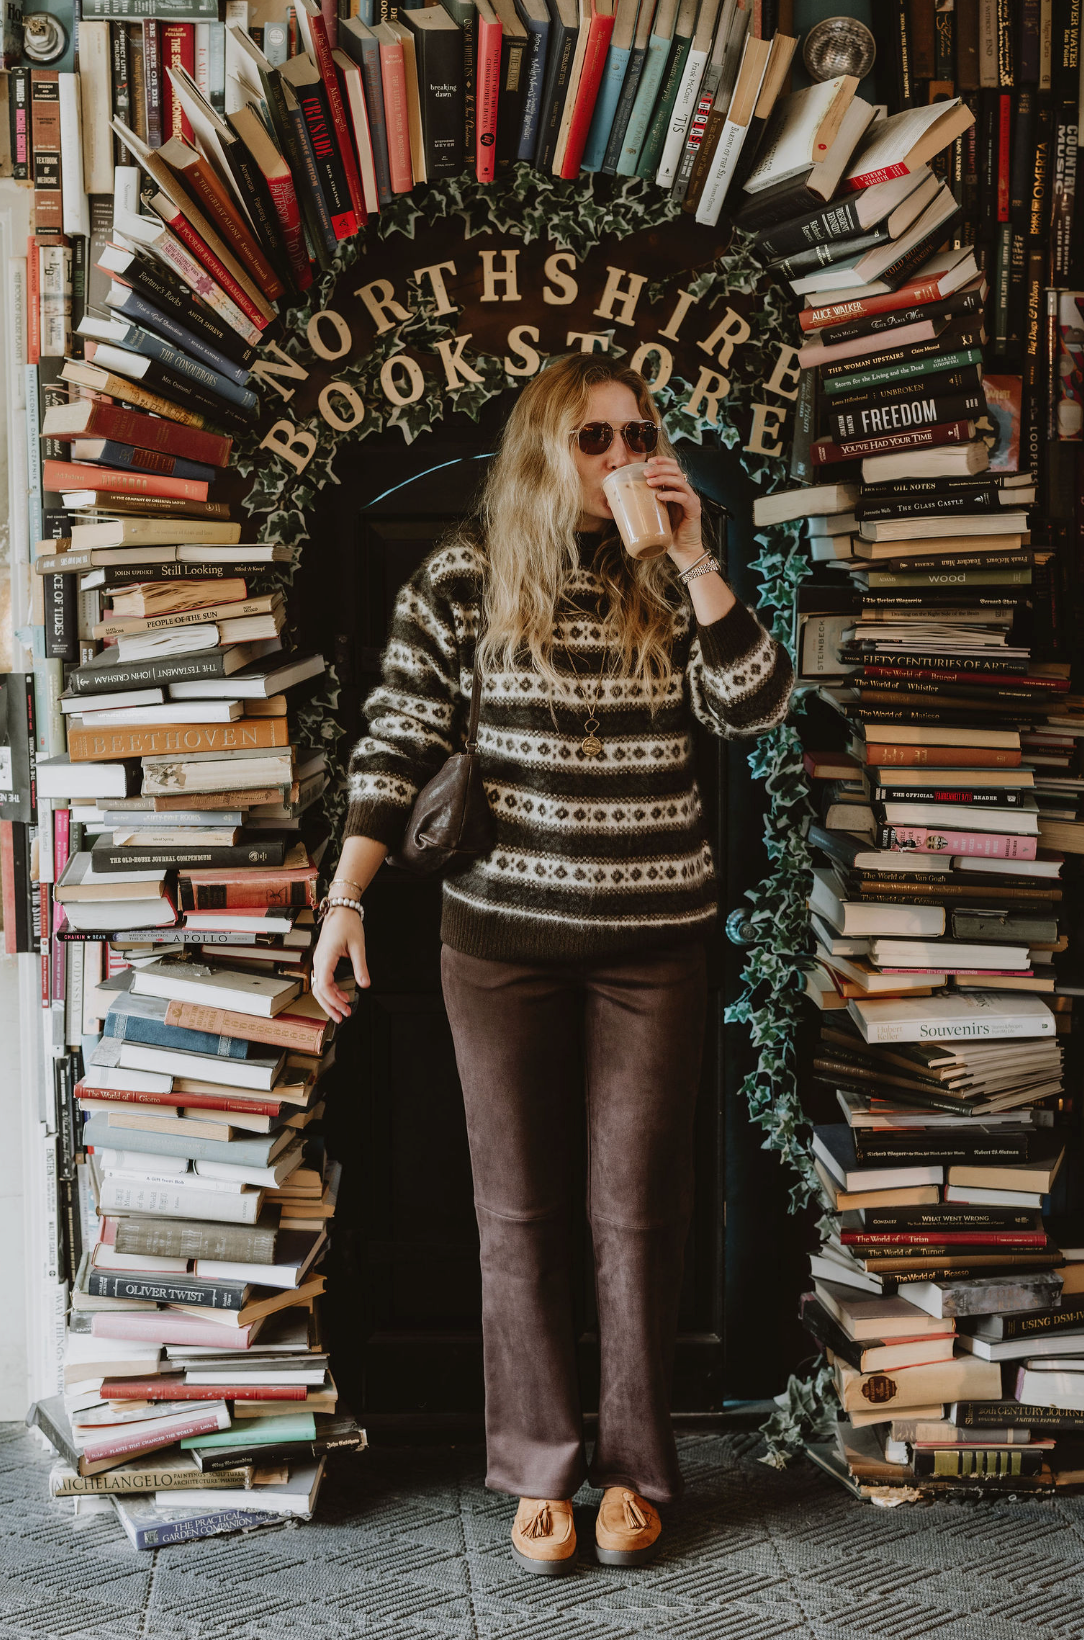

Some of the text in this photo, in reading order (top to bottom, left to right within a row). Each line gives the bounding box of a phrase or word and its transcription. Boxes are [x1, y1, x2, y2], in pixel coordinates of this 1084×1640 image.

[171, 38, 181, 53] THE
[1069, 28, 1079, 68] WATER
[430, 83, 457, 92] breaking
[302, 97, 334, 159] CRUSADE
[673, 114, 688, 133] 'TIS
[686, 98, 712, 151] THE CLASH
[1032, 142, 1048, 198] OMERTA
[1056, 125, 1065, 195] MUSIC
[1064, 125, 1078, 196] COUNTRY
[826, 211, 841, 235] KENNEDY
[836, 207, 850, 232] PRESIDENT
[810, 220, 825, 241] Richard
[884, 259, 904, 278] COLD
[138, 271, 224, 339] Fortune's Rocks ANITA SHREVE
[812, 302, 862, 321] ALICE WALKER
[249, 249, 801, 403] NORTHSHIRE
[159, 347, 218, 387] THE CONQUERORS
[828, 366, 842, 374] THE
[844, 361, 871, 371] WOMAN
[873, 352, 904, 364] UPSTAIRS
[835, 380, 852, 389] Storm
[872, 370, 890, 380] Living
[861, 399, 937, 434] FREEDOM
[841, 433, 932, 454] YOU'VE HAD YOUR TIME
[909, 483, 936, 491] NOTES
[913, 502, 936, 510] GLASS
[937, 499, 963, 508] CASTLE
[162, 565, 181, 576] Still
[184, 565, 223, 576] Looking
[929, 573, 966, 583] wood
[53, 594, 64, 636] OF TIDES
[147, 611, 218, 628] PEOPLE OF THE SUN
[864, 655, 1009, 670] FIFTY CENTURIES OF ART
[94, 663, 217, 684] THE TESTAMENT JOHN GRISHAM
[870, 679, 890, 689] World
[907, 682, 939, 692] Whistler
[92, 726, 259, 754] BEETHOVEN
[173, 934, 228, 942] APOLLO
[920, 1023, 990, 1038] Souvenirs
[100, 1091, 120, 1099] World
[139, 1095, 161, 1103] Giotto
[907, 1274, 928, 1282] World
[126, 1285, 204, 1302] OLIVER TWIST
[1022, 1318, 1051, 1330] USING
[997, 1406, 1045, 1416] CENTURY
[109, 1444, 126, 1454] PLANTS
[128, 1442, 141, 1450] THAT
[142, 1436, 165, 1448] CHANGED
[175, 1427, 193, 1438] WORLD
[56, 1474, 172, 1491] MICHELANGELO
[162, 1517, 253, 1542] GARDEN COMPANION
[172, 1511, 242, 1532] THE PRACTICAL
